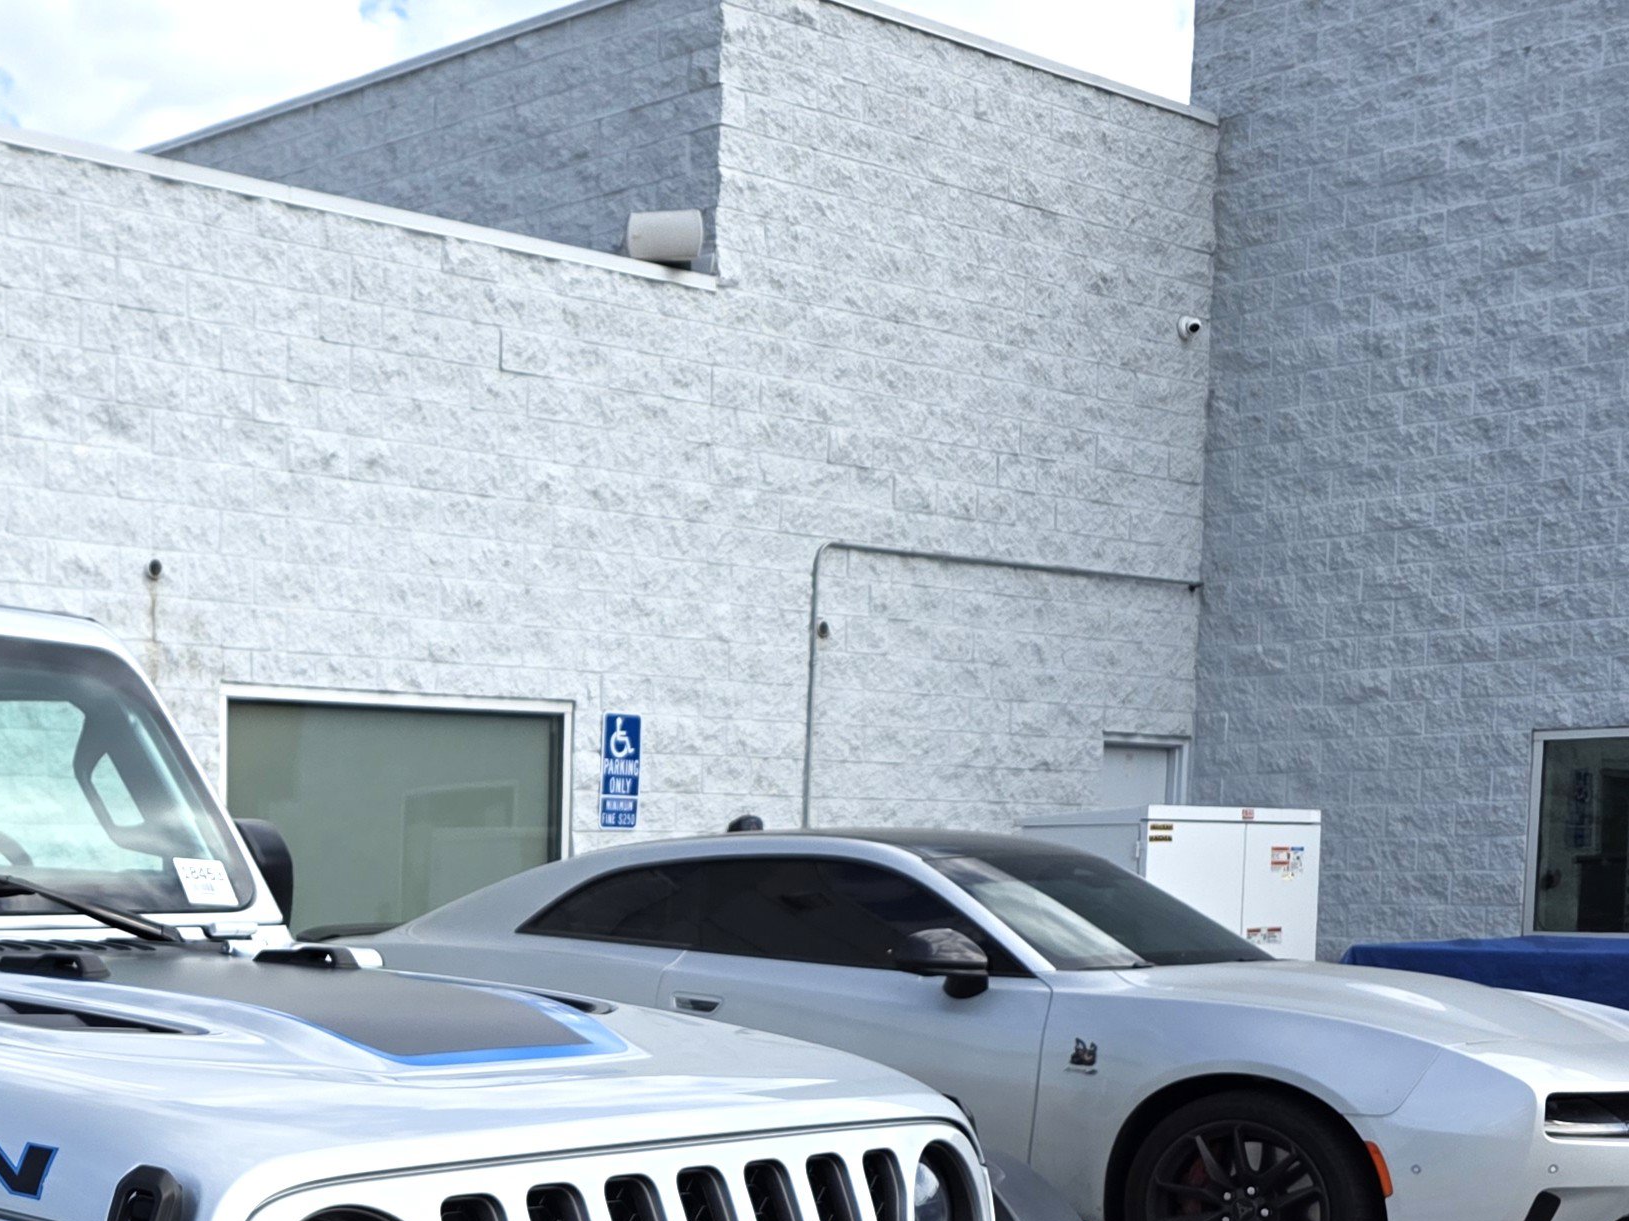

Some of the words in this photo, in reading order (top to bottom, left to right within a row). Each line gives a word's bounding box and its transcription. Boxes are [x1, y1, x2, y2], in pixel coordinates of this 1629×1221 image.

[603, 757, 639, 776] PARKING
[609, 777, 632, 794] ONLY
[605, 800, 633, 812] MINIMUM
[601, 812, 616, 825] FINE
[618, 812, 635, 826] $250
